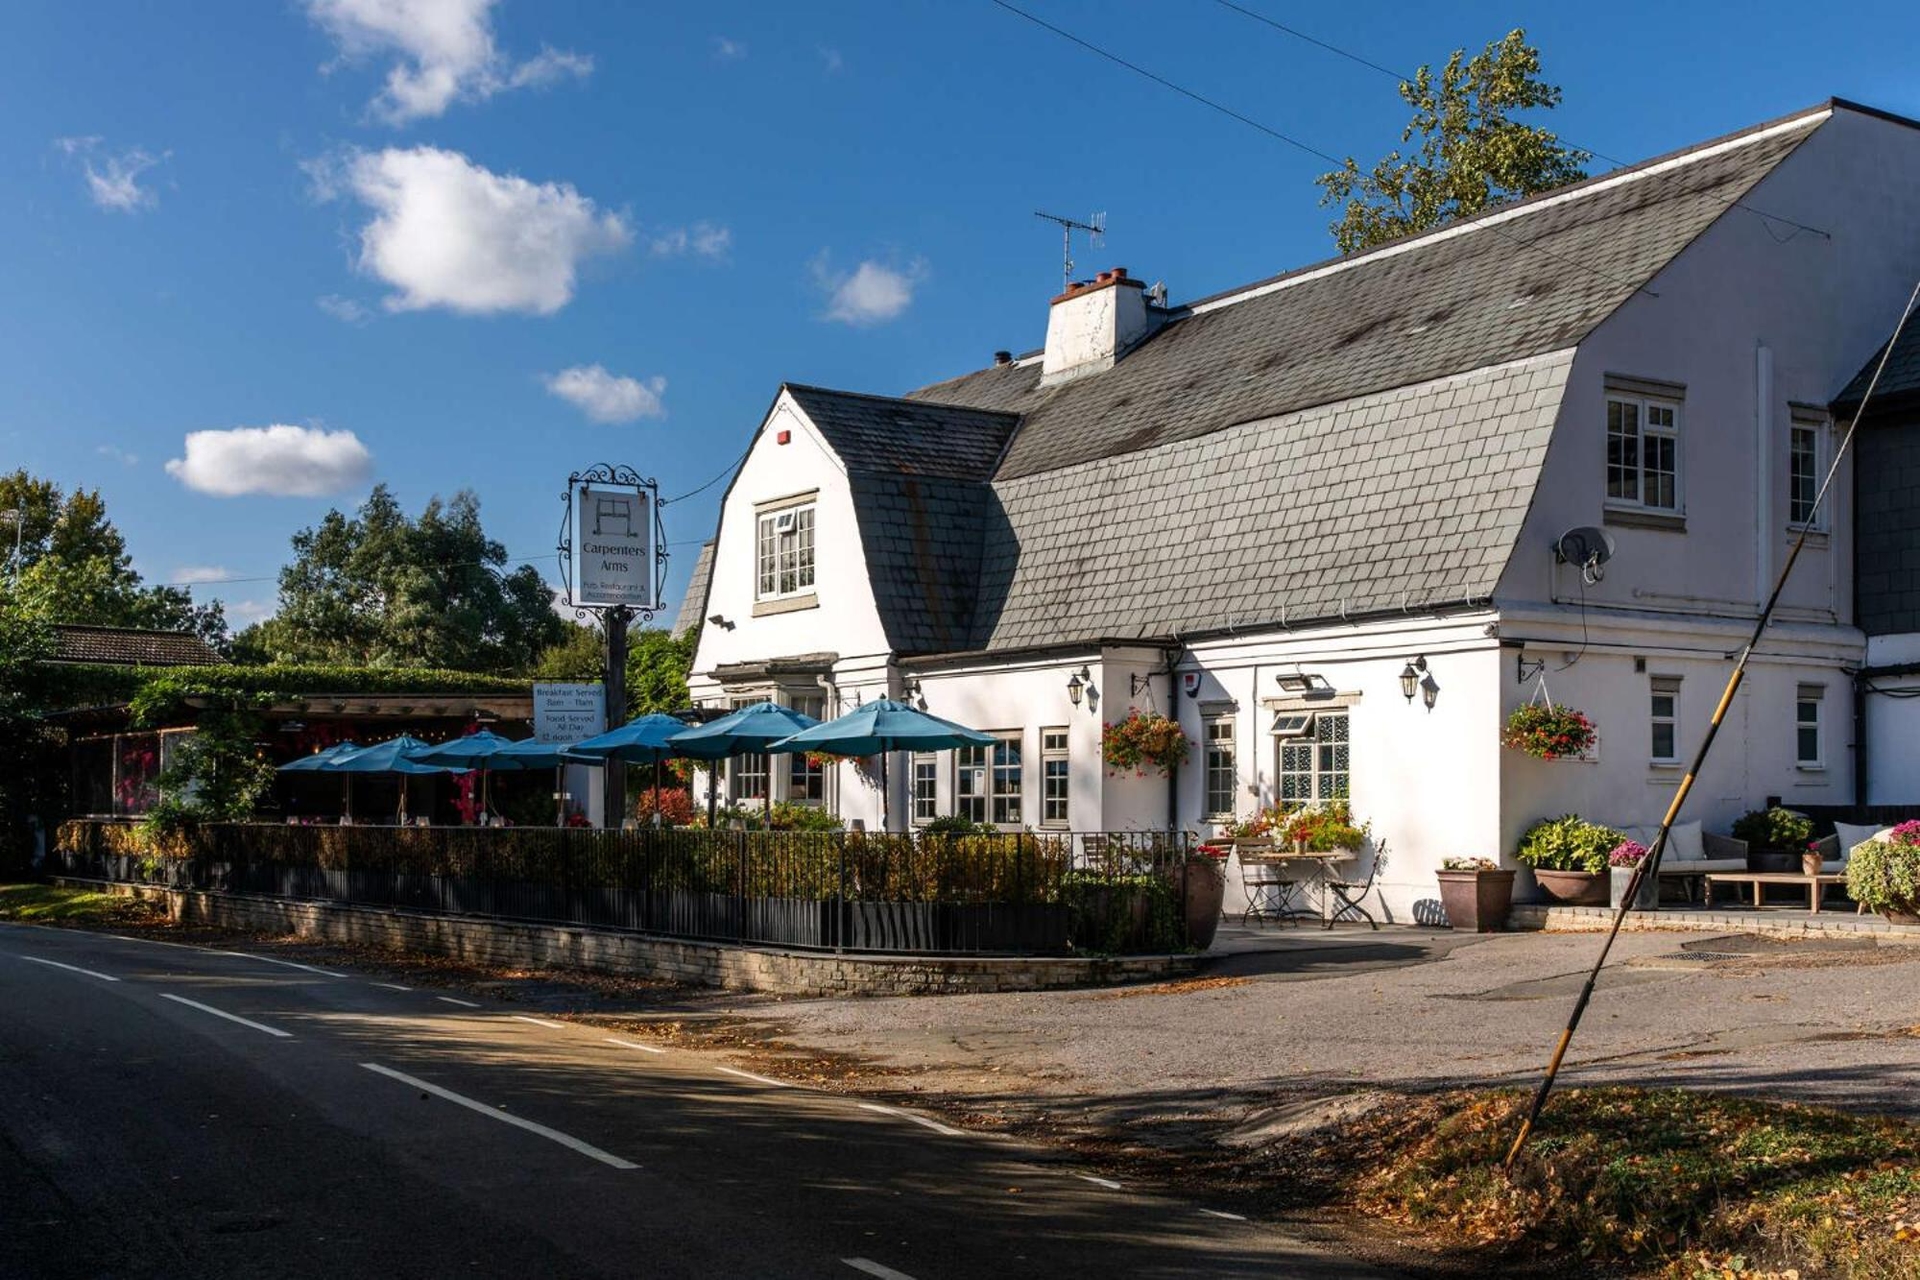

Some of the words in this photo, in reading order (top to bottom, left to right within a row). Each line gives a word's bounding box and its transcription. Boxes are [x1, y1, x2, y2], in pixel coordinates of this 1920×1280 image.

[583, 542, 646, 557] Carpenters
[601, 560, 629, 573] Arms
[537, 688, 573, 697] Breakfast
[575, 688, 603, 697] Served
[545, 715, 566, 723] Food
[567, 715, 595, 723] Served
[568, 723, 584, 731] Day
